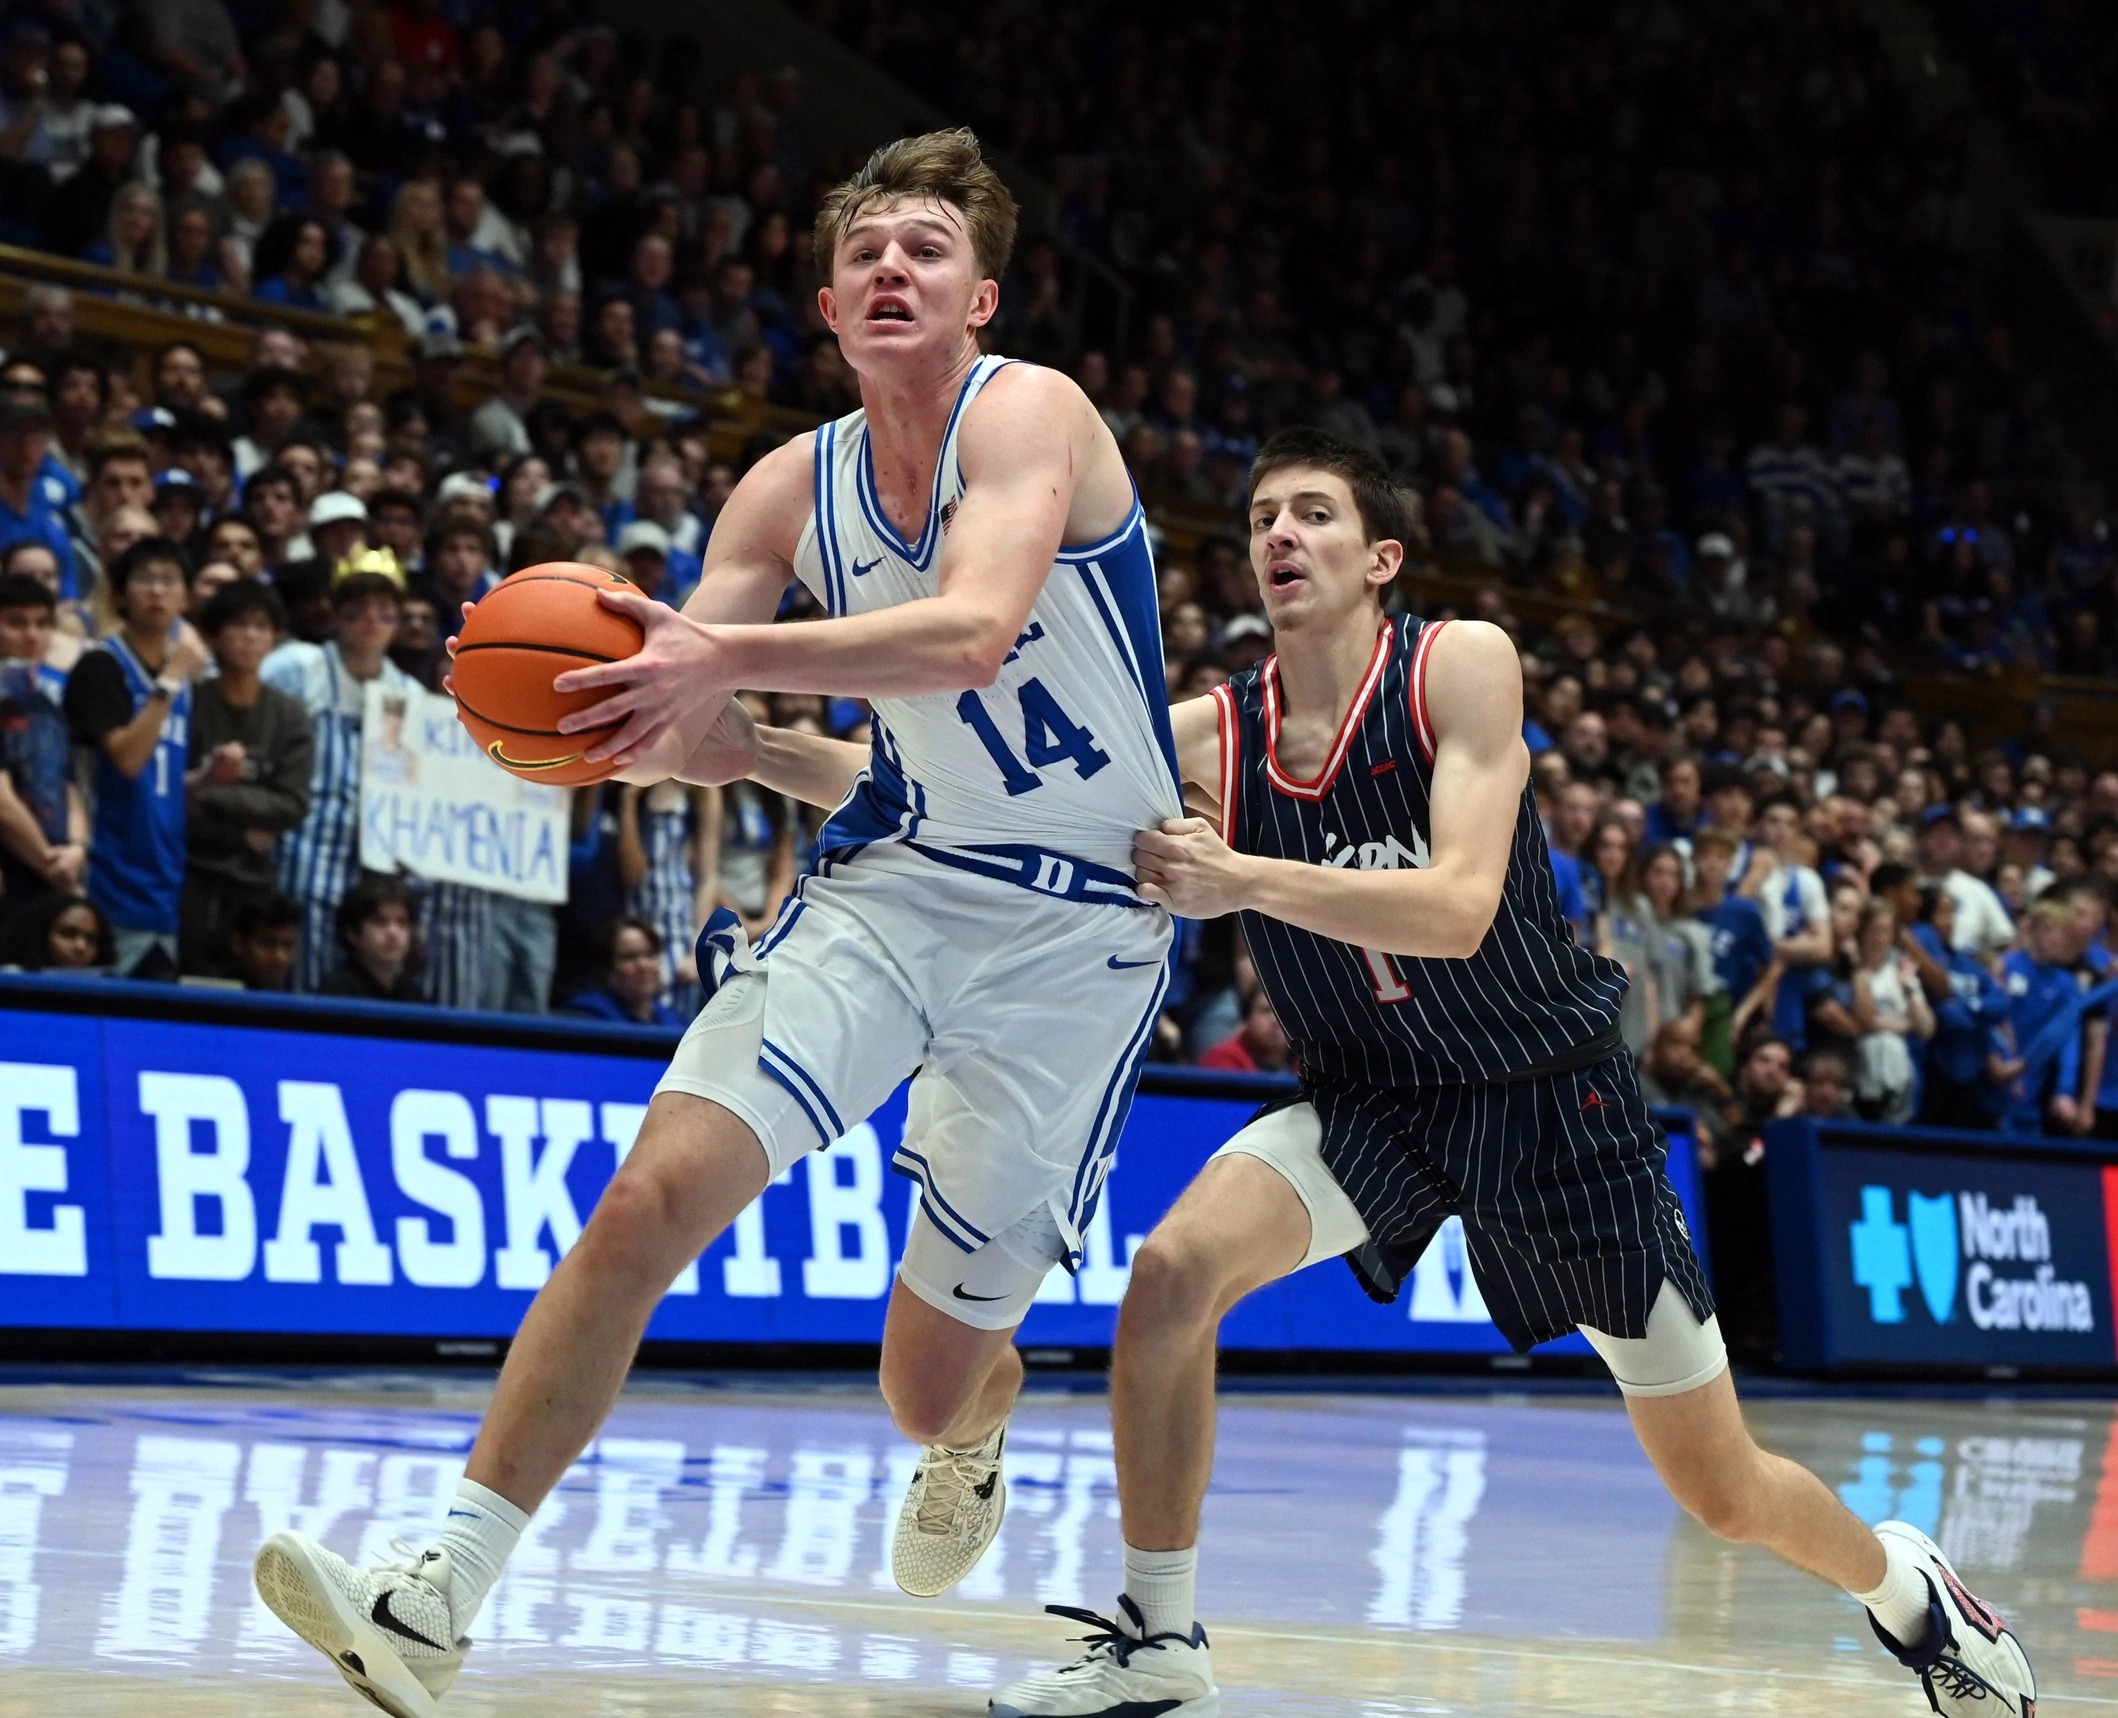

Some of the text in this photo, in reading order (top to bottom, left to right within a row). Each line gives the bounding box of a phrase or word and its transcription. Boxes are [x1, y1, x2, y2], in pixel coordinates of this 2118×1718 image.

[956, 676, 1112, 797] 14
[137, 1069, 1148, 1306] BASKTBL
[1959, 1190, 2051, 1262] North
[1967, 1261, 2094, 1333] Carolina
